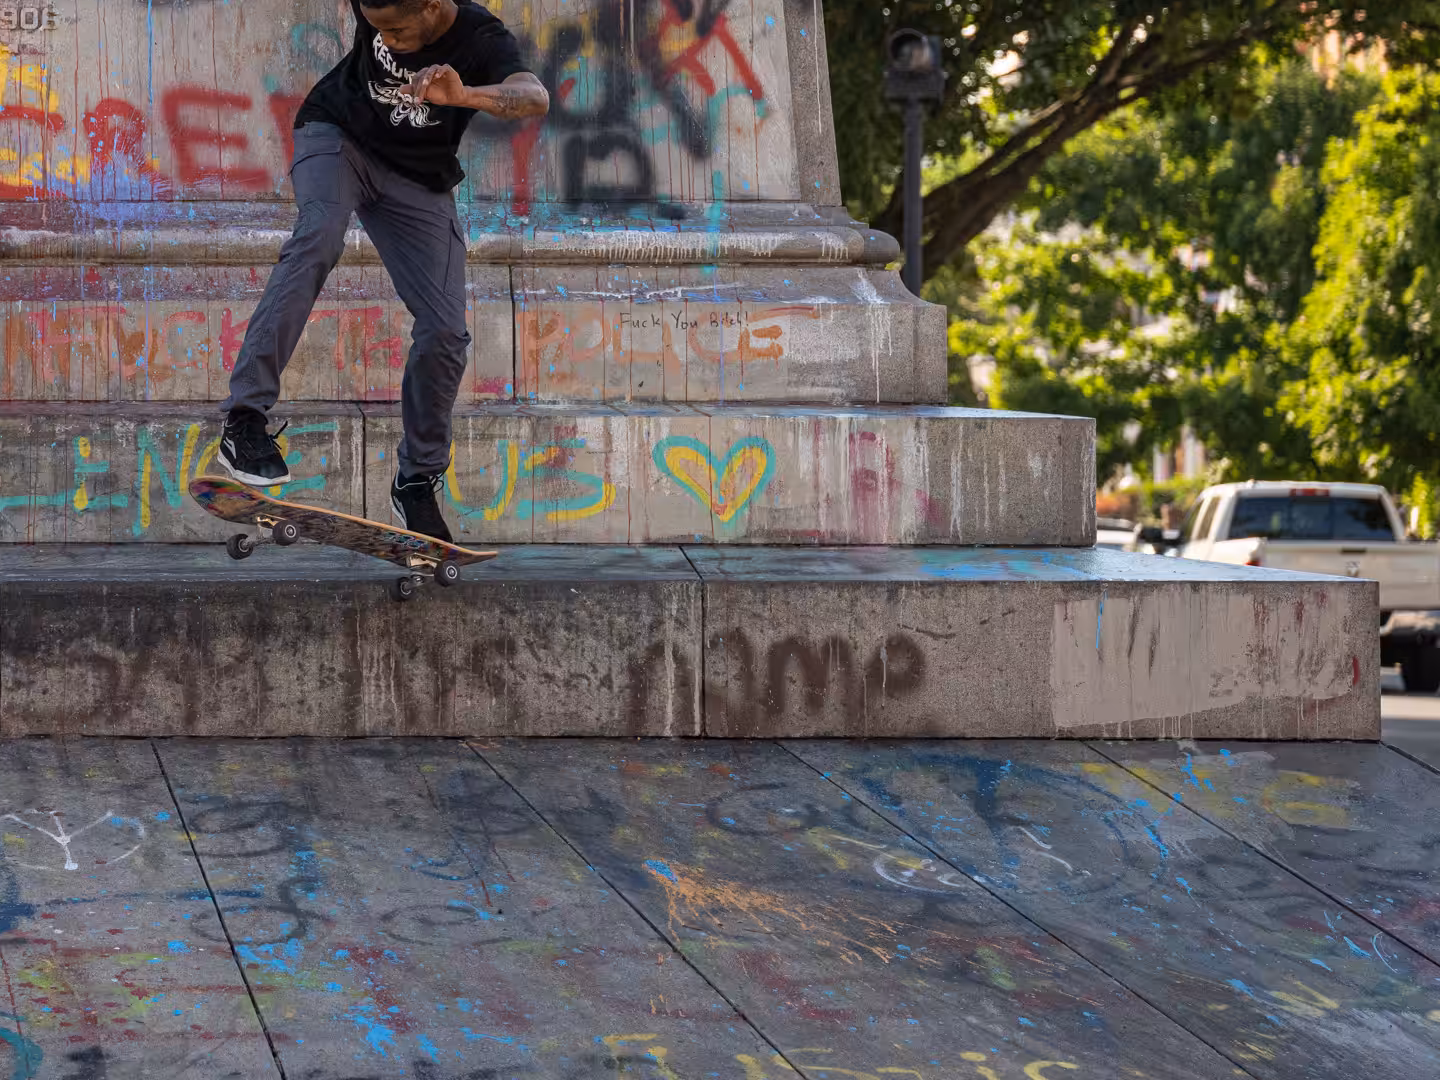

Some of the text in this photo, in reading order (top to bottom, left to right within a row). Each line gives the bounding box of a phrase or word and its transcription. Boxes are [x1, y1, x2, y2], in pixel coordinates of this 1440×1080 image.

[372, 31, 418, 85] RESUR
[671, 310, 698, 329] You
[443, 436, 617, 522] US
